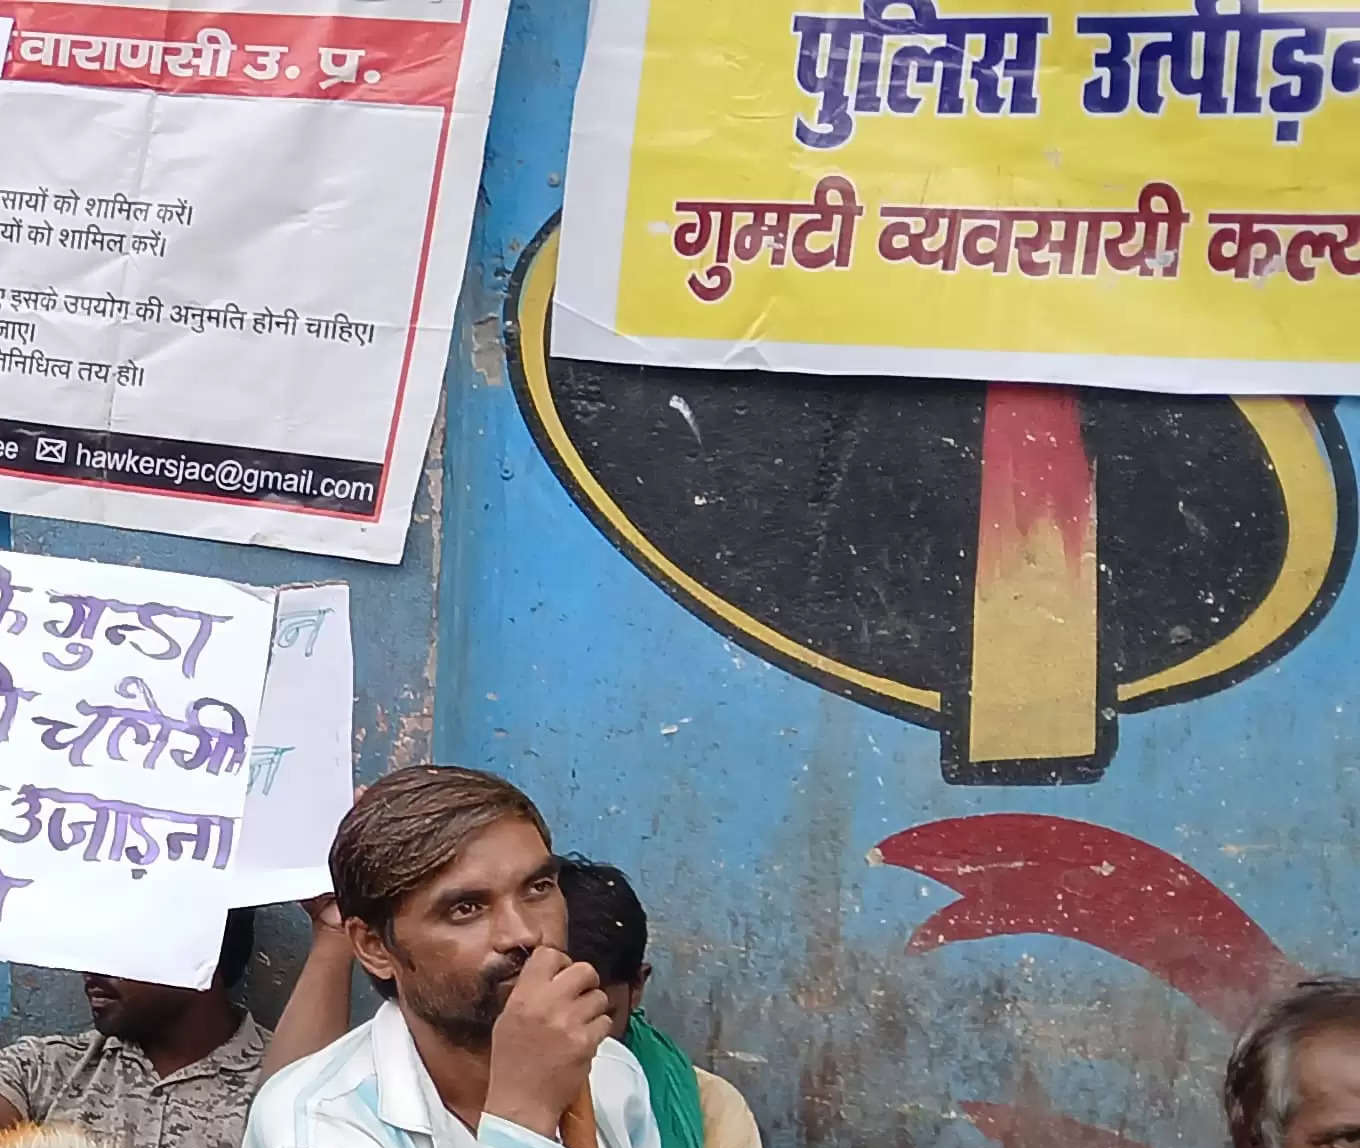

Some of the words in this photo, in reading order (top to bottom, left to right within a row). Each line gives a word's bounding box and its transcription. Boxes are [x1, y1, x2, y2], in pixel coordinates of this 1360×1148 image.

[18, 28, 237, 78] वाराणसी
[791, 0, 1050, 149] पुलिस
[53, 188, 81, 216] को
[84, 192, 153, 222] शामिल
[27, 219, 55, 247] को
[58, 223, 125, 255] शामिल
[671, 175, 864, 302] गुमटी
[878, 181, 1190, 279] व्यवसायी
[10, 285, 59, 312] इसके
[63, 291, 131, 320] उपयोग
[135, 295, 165, 324] की
[169, 302, 248, 334] अनुमति
[252, 306, 300, 336] होनी
[75, 443, 375, 502] hawkersjac@gmail.com
